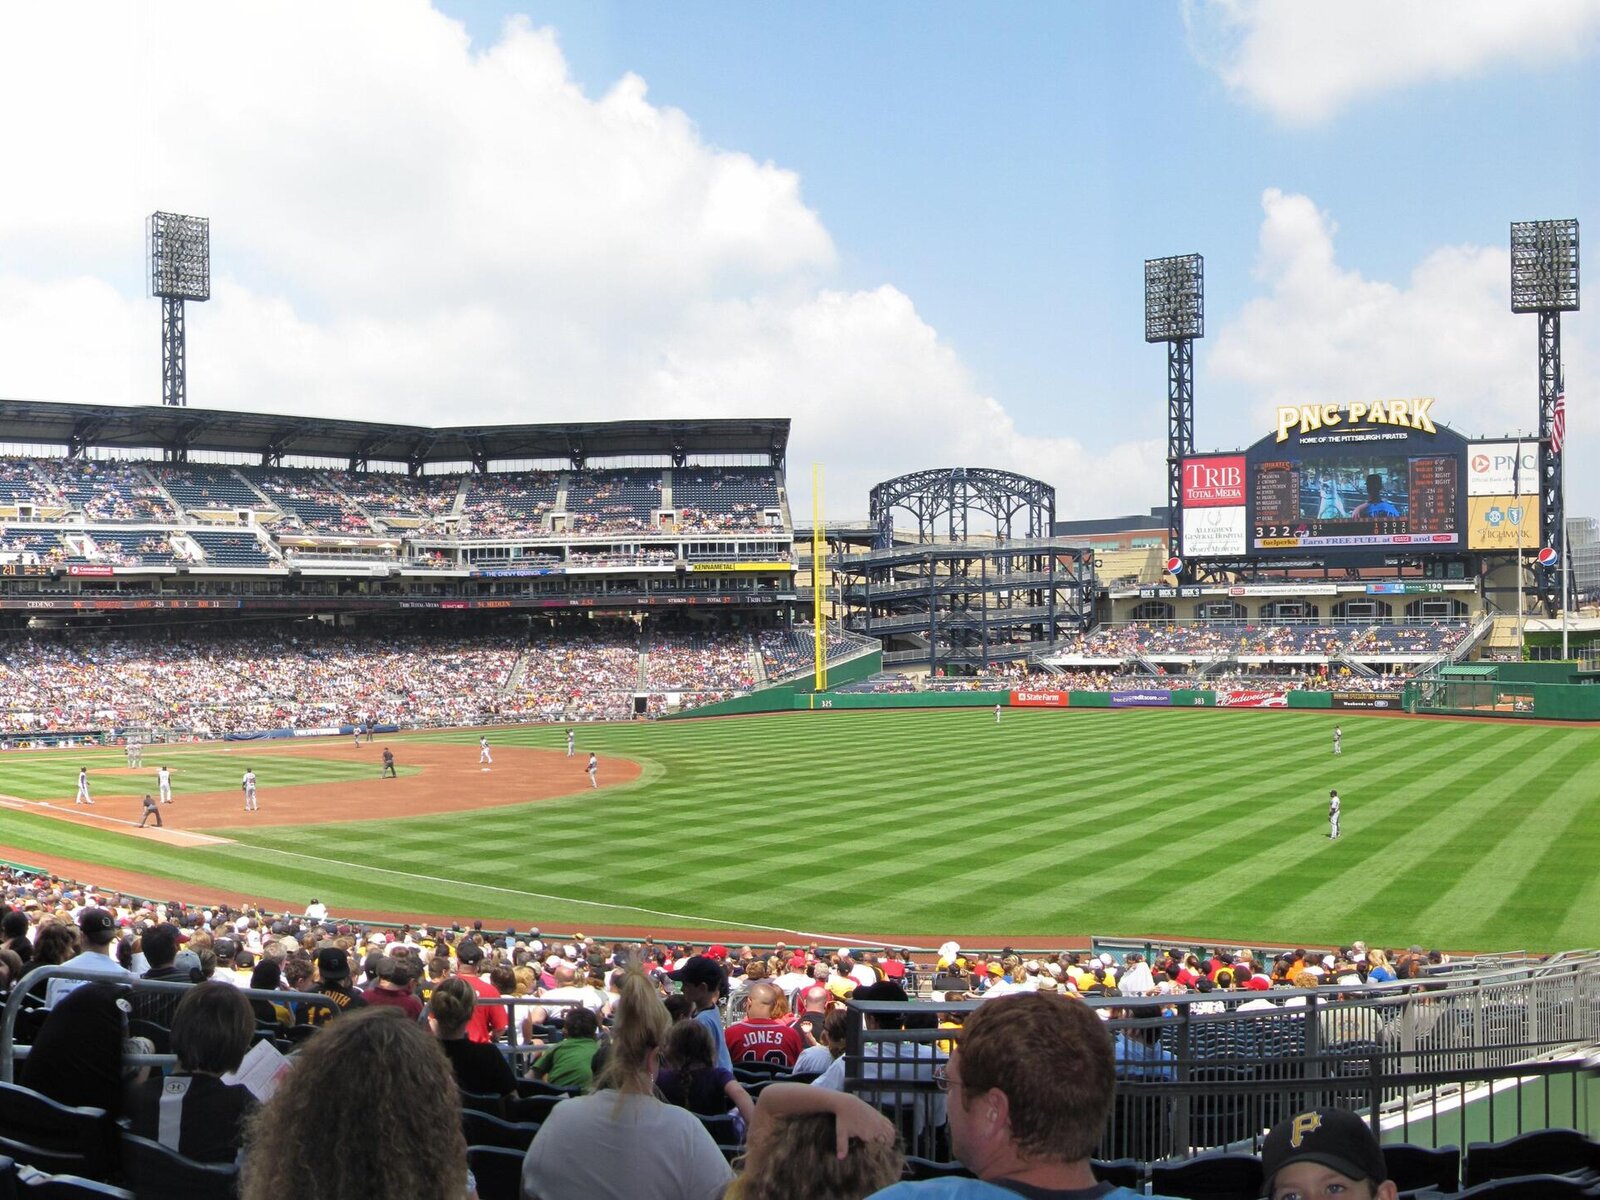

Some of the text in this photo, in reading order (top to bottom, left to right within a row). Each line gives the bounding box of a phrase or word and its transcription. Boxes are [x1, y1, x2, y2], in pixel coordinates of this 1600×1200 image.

[1276, 397, 1437, 443] PNC PARK
[1299, 436, 1319, 445] HOME
[1329, 435, 1341, 443] THE
[1342, 433, 1381, 442] PITTSBURGH
[1382, 432, 1408, 441] PIRATES
[1186, 464, 1242, 489] TRIB
[1187, 488, 1242, 499] TOTAL MEDIA
[1256, 525, 1291, 537] 3 2 2
[1263, 539, 1298, 547] fuelperks!
[694, 562, 734, 570] KENNAMETAL
[1026, 693, 1059, 701] State Farm
[1194, 697, 1205, 705] 383
[1221, 691, 1275, 706] Budweiser
[821, 700, 832, 708] 325
[743, 1030, 784, 1048] JONES
[1290, 1111, 1323, 1148] P
